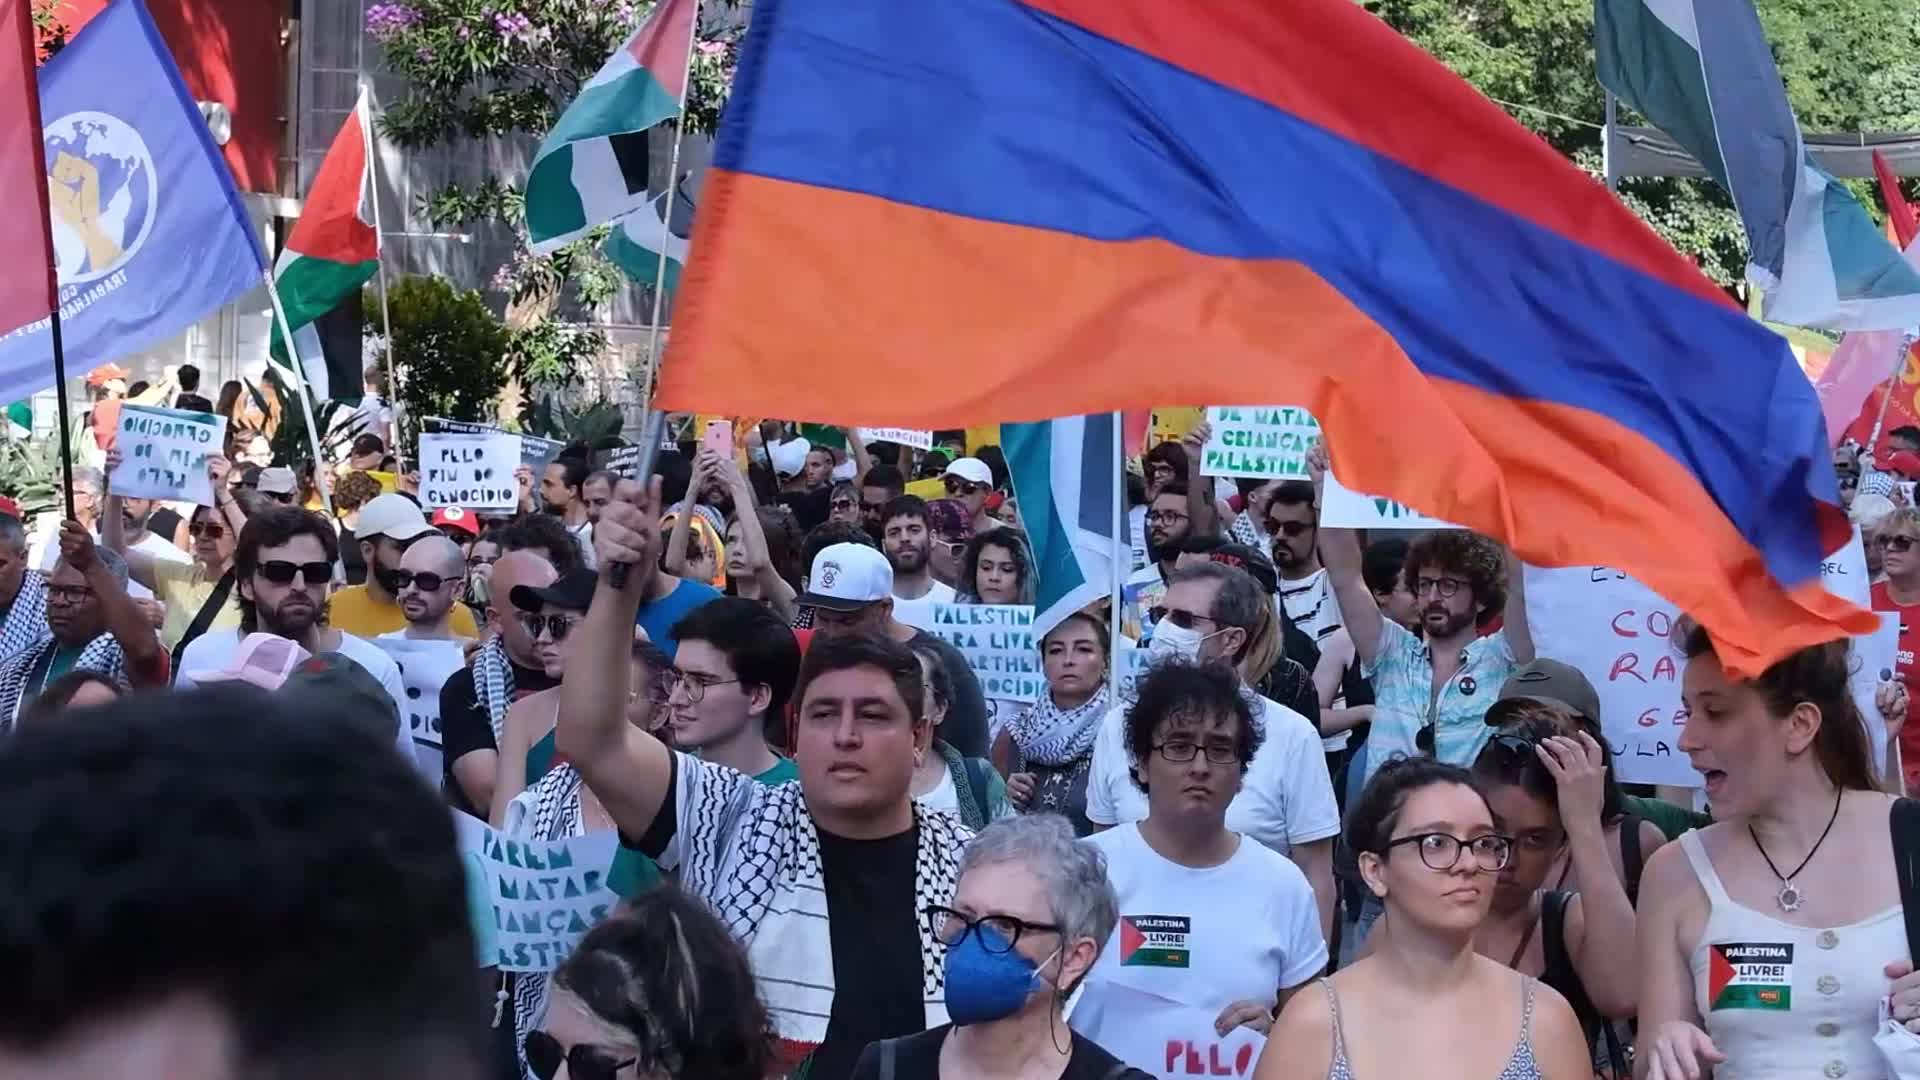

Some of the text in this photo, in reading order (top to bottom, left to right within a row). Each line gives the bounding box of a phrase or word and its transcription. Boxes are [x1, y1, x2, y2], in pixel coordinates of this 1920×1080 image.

[440, 447, 483, 463] PELO
[429, 467, 493, 482] FIM DO
[934, 607, 1031, 625] PALESTIN
[990, 631, 1033, 650] LIVR
[483, 828, 573, 871] PAREM
[499, 870, 601, 901] MATAR
[1135, 919, 1185, 929] PALESTINA
[1149, 933, 1185, 943] LIVRE!
[1725, 947, 1787, 957] PALESTINA
[1739, 965, 1785, 976] LIVRE!
[1166, 1041, 1252, 1077] PELO
